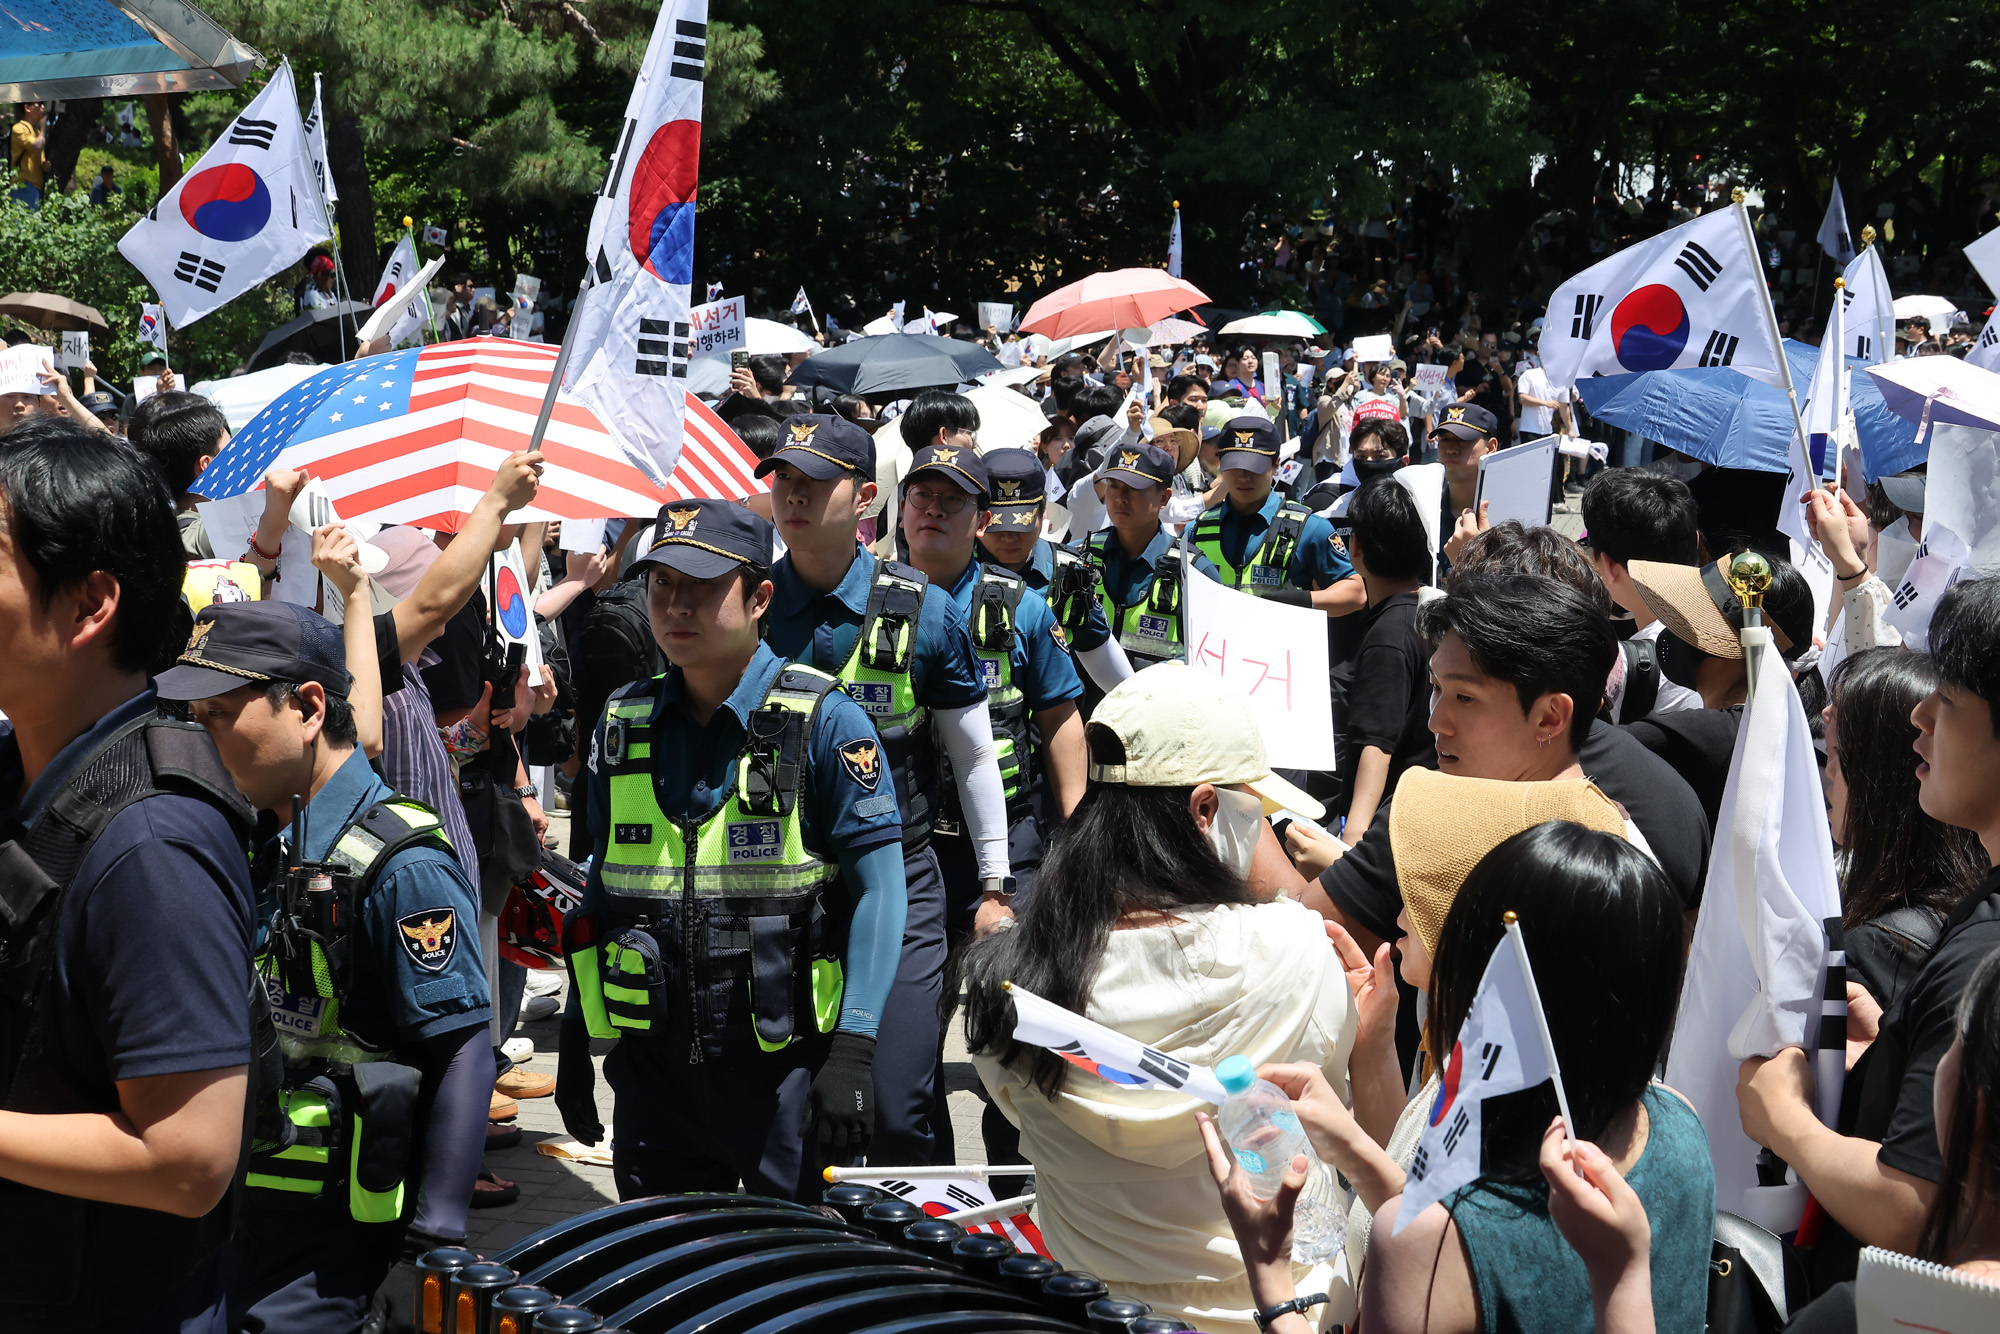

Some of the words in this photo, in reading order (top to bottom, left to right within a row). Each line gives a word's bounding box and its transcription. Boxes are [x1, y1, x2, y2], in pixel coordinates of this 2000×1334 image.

[1373, 402, 1397, 414] AMERICA
[1253, 577, 1279, 585] POLICE
[1142, 617, 1166, 630] 경찰
[1139, 629, 1164, 638] POLICE
[851, 685, 889, 702] 경찰
[860, 704, 889, 713] OLICE
[861, 772, 877, 780] POLICE
[731, 823, 776, 845] 경찰
[733, 847, 779, 860] POLICE
[421, 949, 446, 960] POLICE
[851, 1008, 874, 1020] POLICE
[271, 1011, 313, 1032] OLICE
[854, 1090, 864, 1111] POLICE
